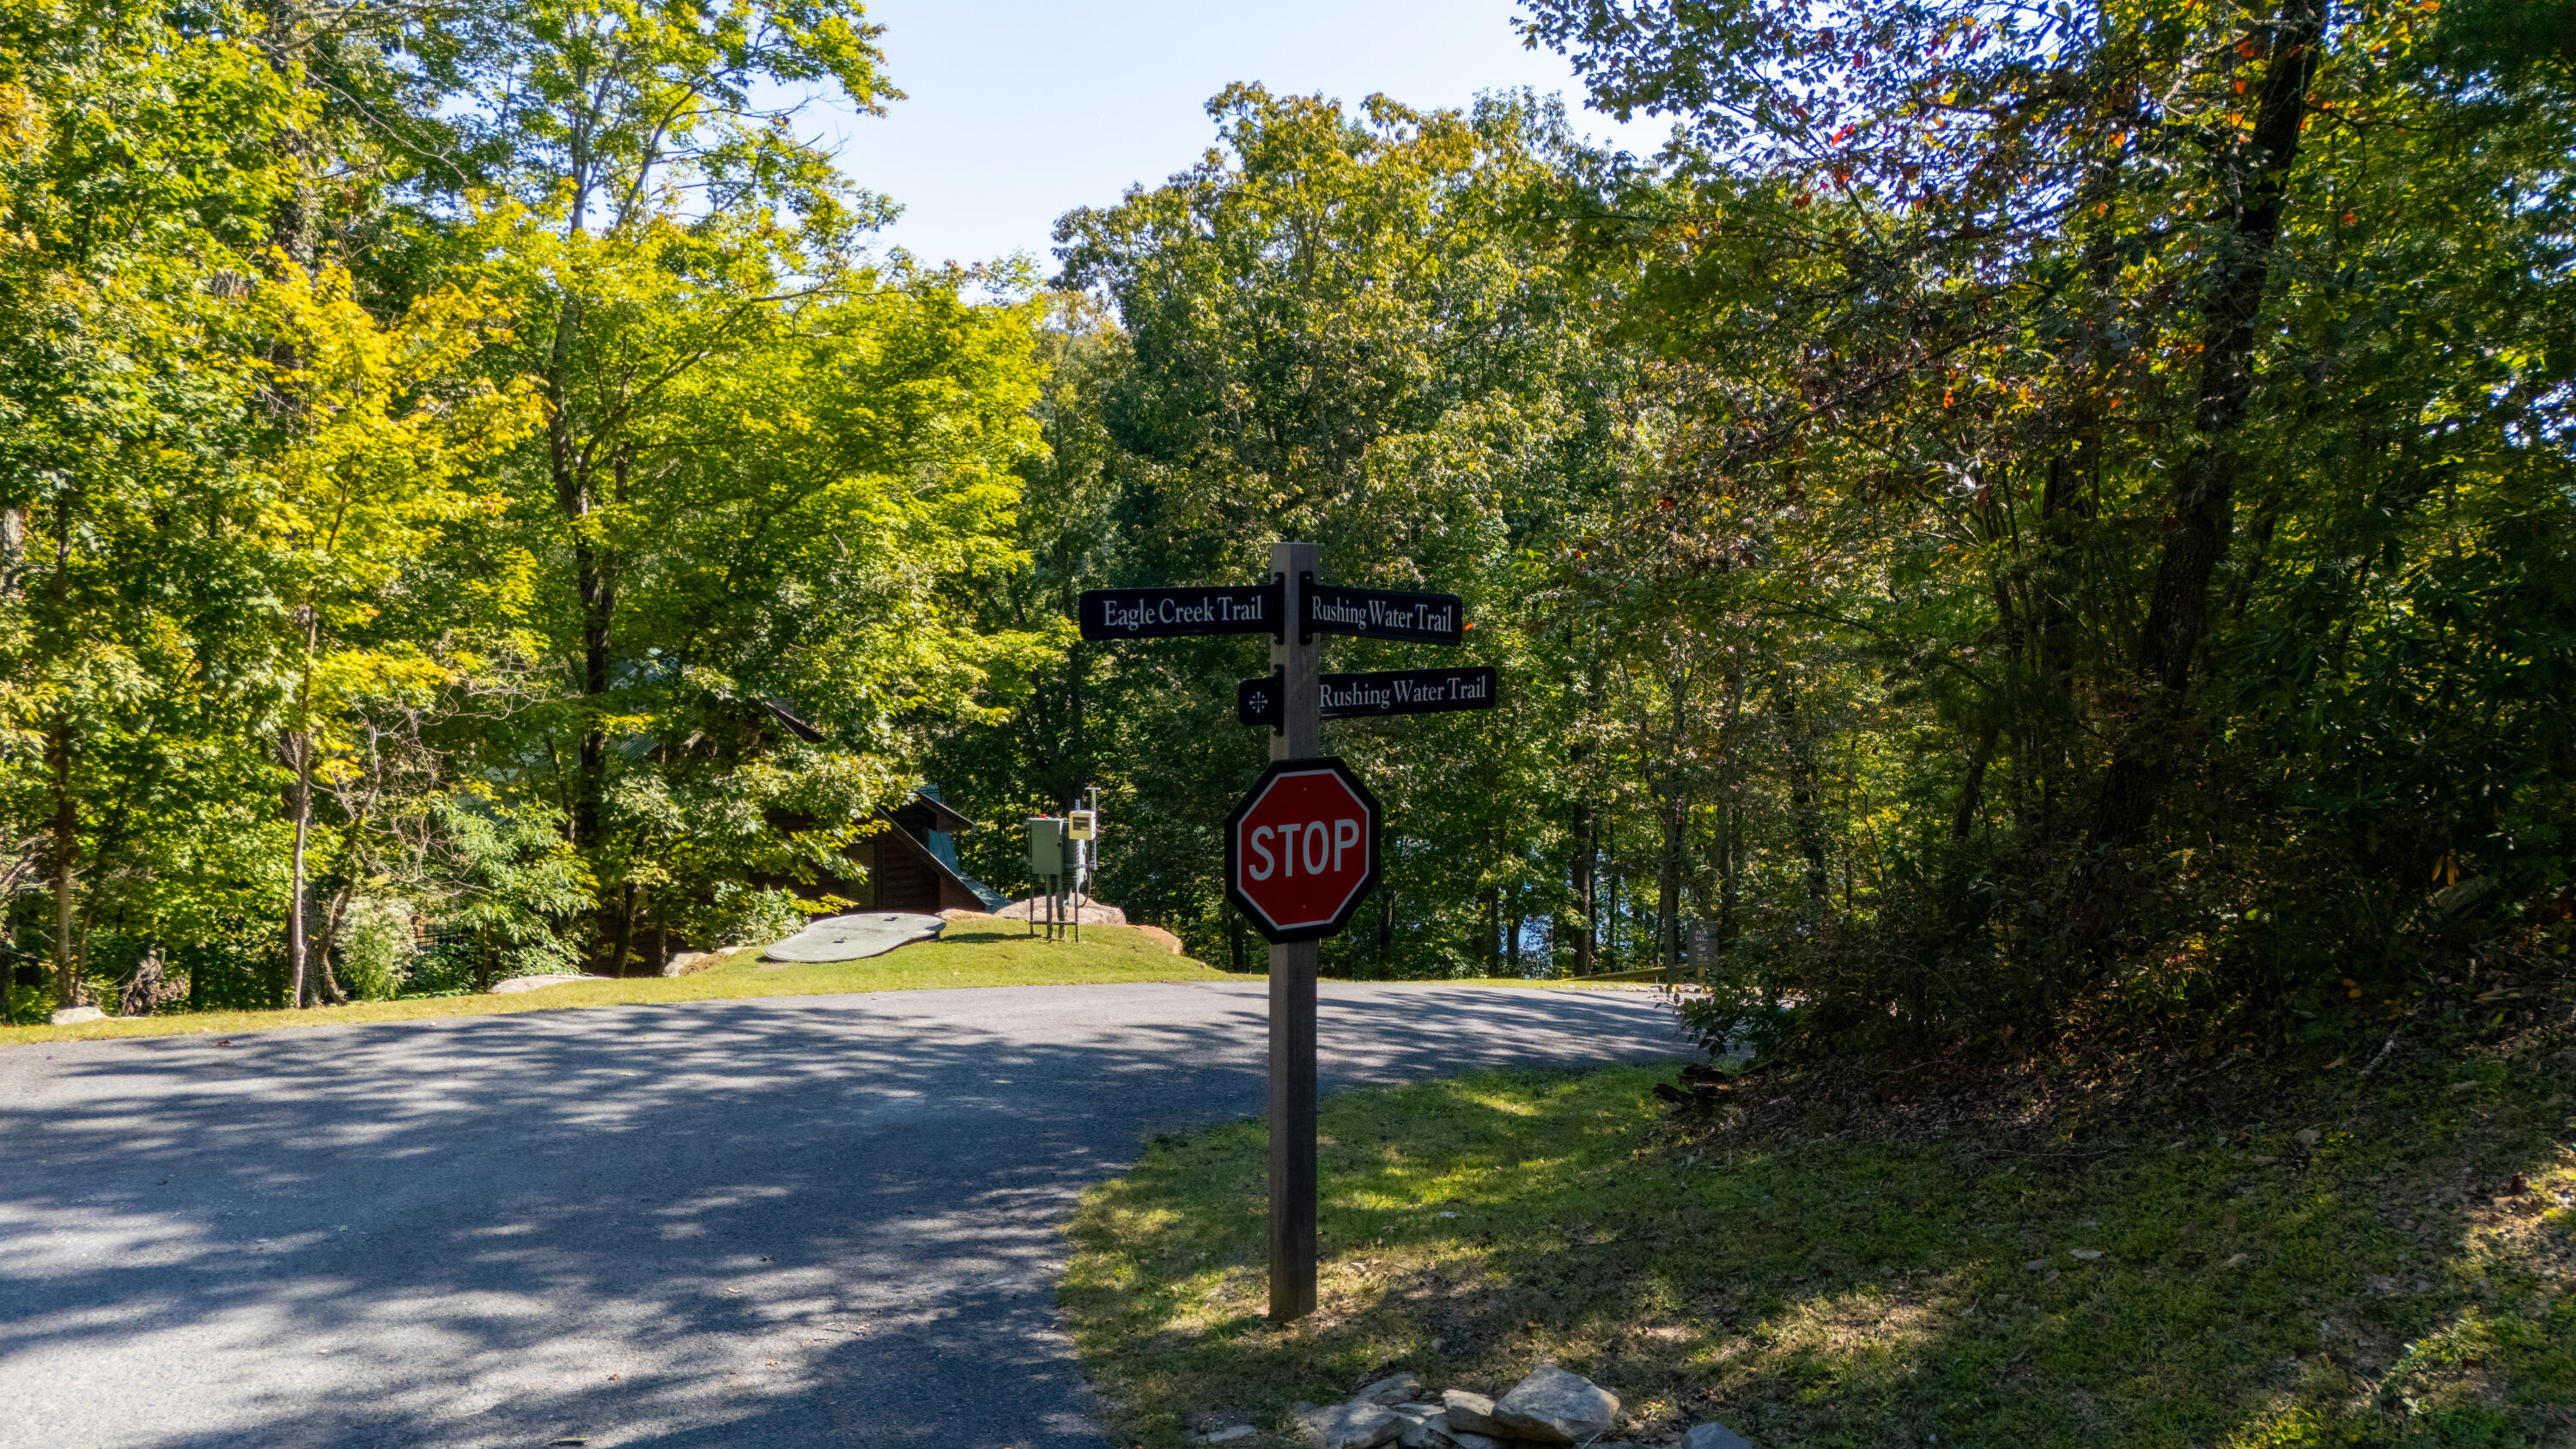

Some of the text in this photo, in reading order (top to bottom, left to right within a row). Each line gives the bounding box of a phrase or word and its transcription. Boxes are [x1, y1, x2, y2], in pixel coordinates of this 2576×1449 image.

[1103, 594, 1263, 631] Eagle Creek Trail
[1312, 595, 1453, 632] Rushing Water Trail
[1319, 674, 1487, 709] Rushing Water Trail
[1249, 819, 1360, 881] STOP
